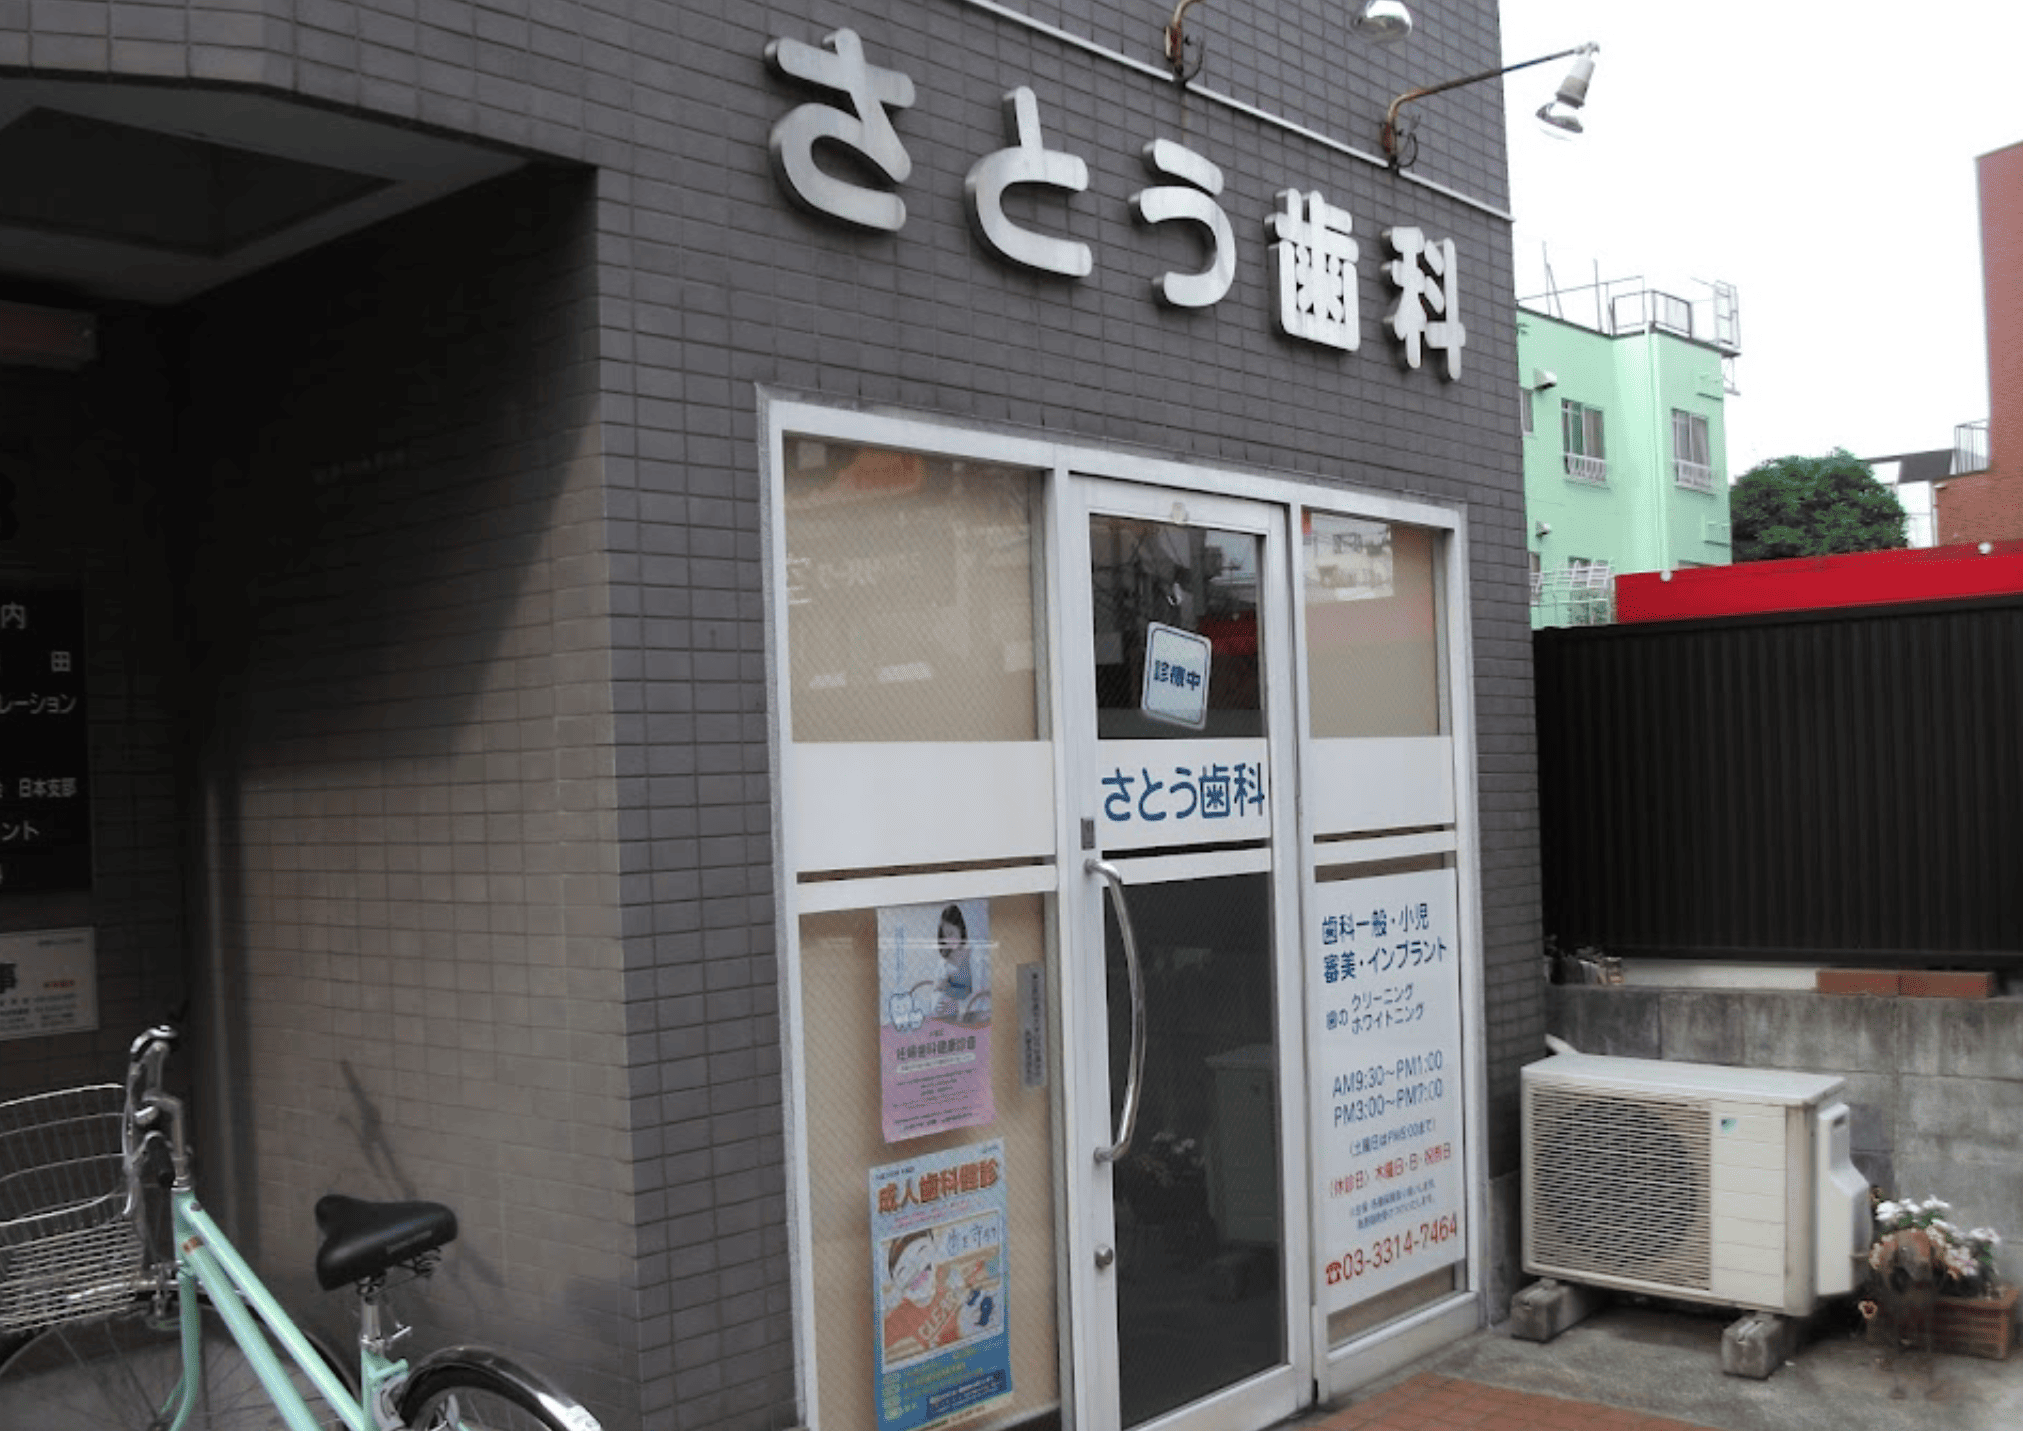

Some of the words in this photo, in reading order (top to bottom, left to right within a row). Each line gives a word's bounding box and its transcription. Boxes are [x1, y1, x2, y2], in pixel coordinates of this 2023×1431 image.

[765, 28, 1465, 381] さとう歯科
[51, 651, 71, 673] 田
[1153, 660, 1201, 691] 診療中
[19, 777, 77, 799] 日本支部
[1101, 762, 1266, 821] さとう歯科
[1322, 903, 1429, 945] 歯科一般・小児
[1352, 982, 1414, 1013] クリーニング
[1352, 1001, 1424, 1035] ホワイトニング
